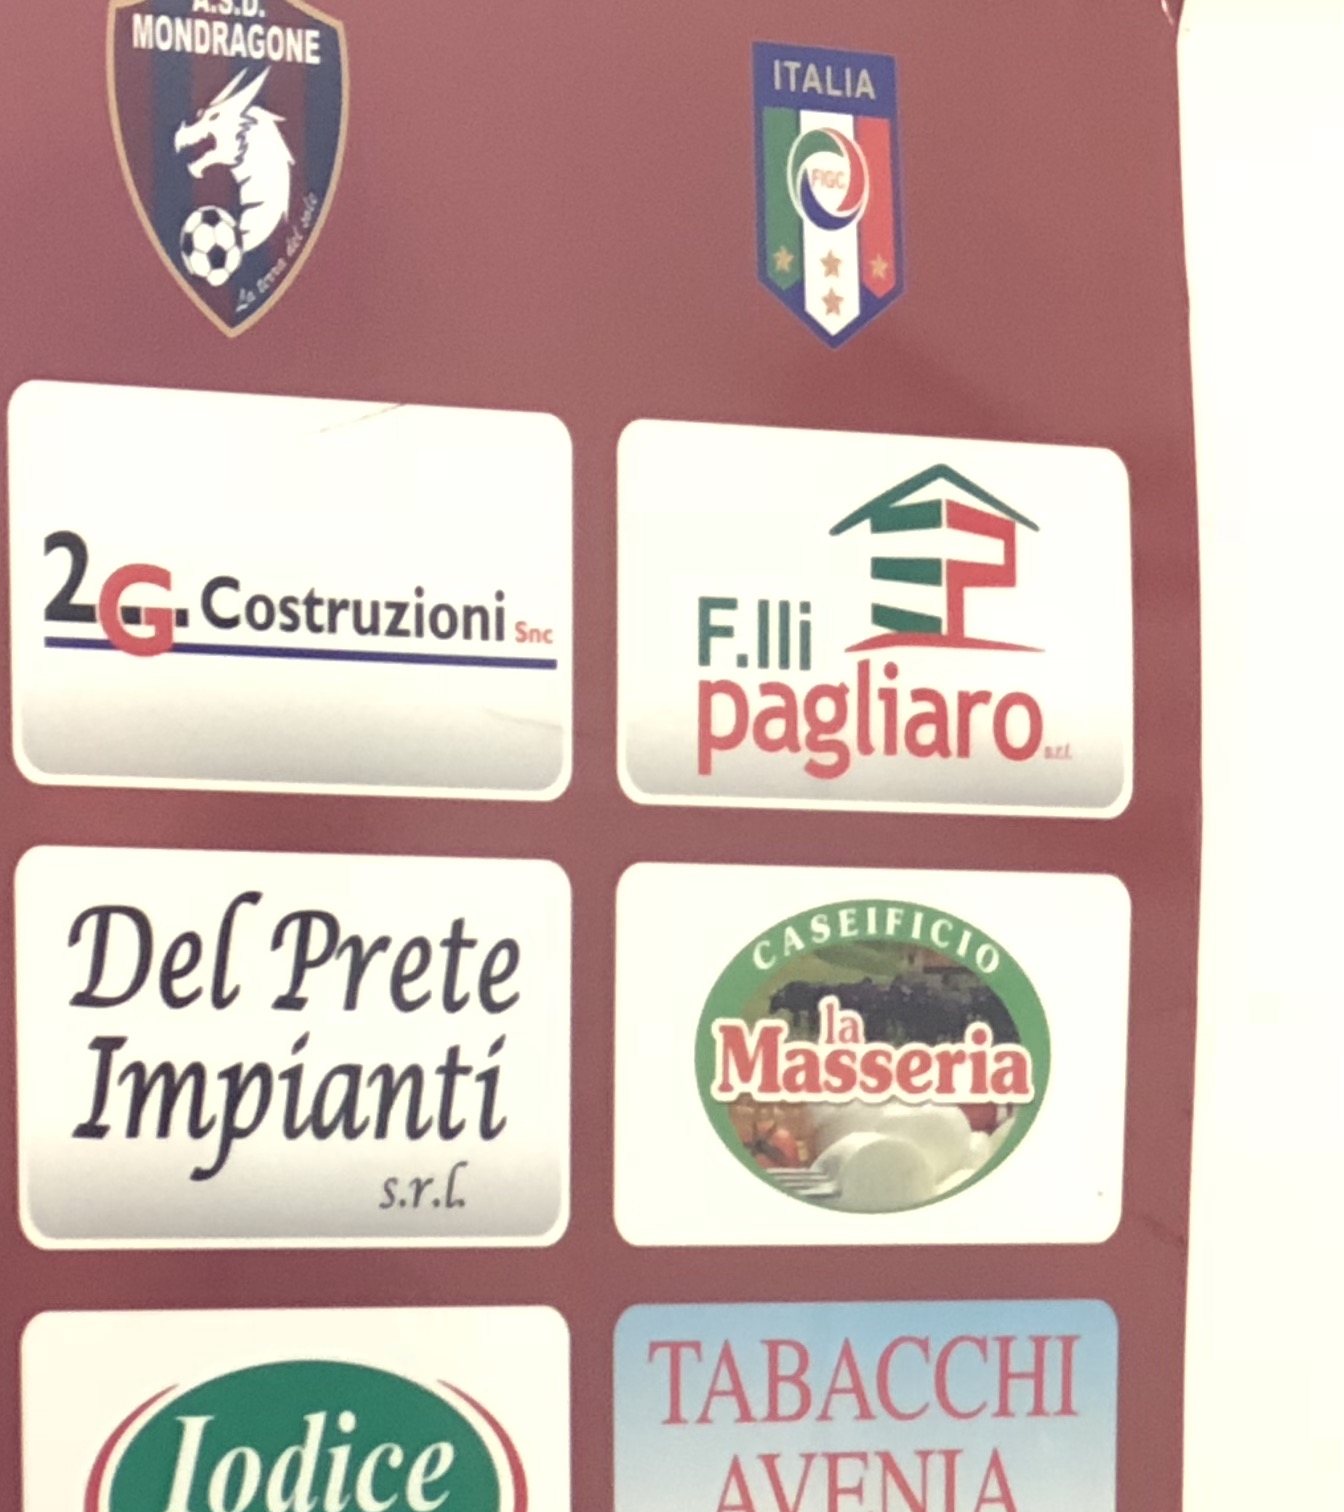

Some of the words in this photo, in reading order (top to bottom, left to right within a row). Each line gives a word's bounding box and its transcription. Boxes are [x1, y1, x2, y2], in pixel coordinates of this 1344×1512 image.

[132, 13, 321, 65] MONDRAGONE
[773, 58, 876, 101] ITALIA
[200, 576, 505, 642] Costruzioni
[514, 620, 554, 645] Snc
[698, 596, 812, 671] F.lli
[697, 658, 1044, 780] pagliaro
[67, 890, 263, 1010] Del
[270, 909, 521, 1014] Prete
[752, 906, 1000, 975] CASEIFICIO
[824, 1002, 861, 1044] la
[717, 1024, 1031, 1095] Masseria
[72, 1031, 507, 1182] Impianti
[379, 1161, 469, 1210] s.r.l.
[648, 1334, 1082, 1425] TABACCHI
